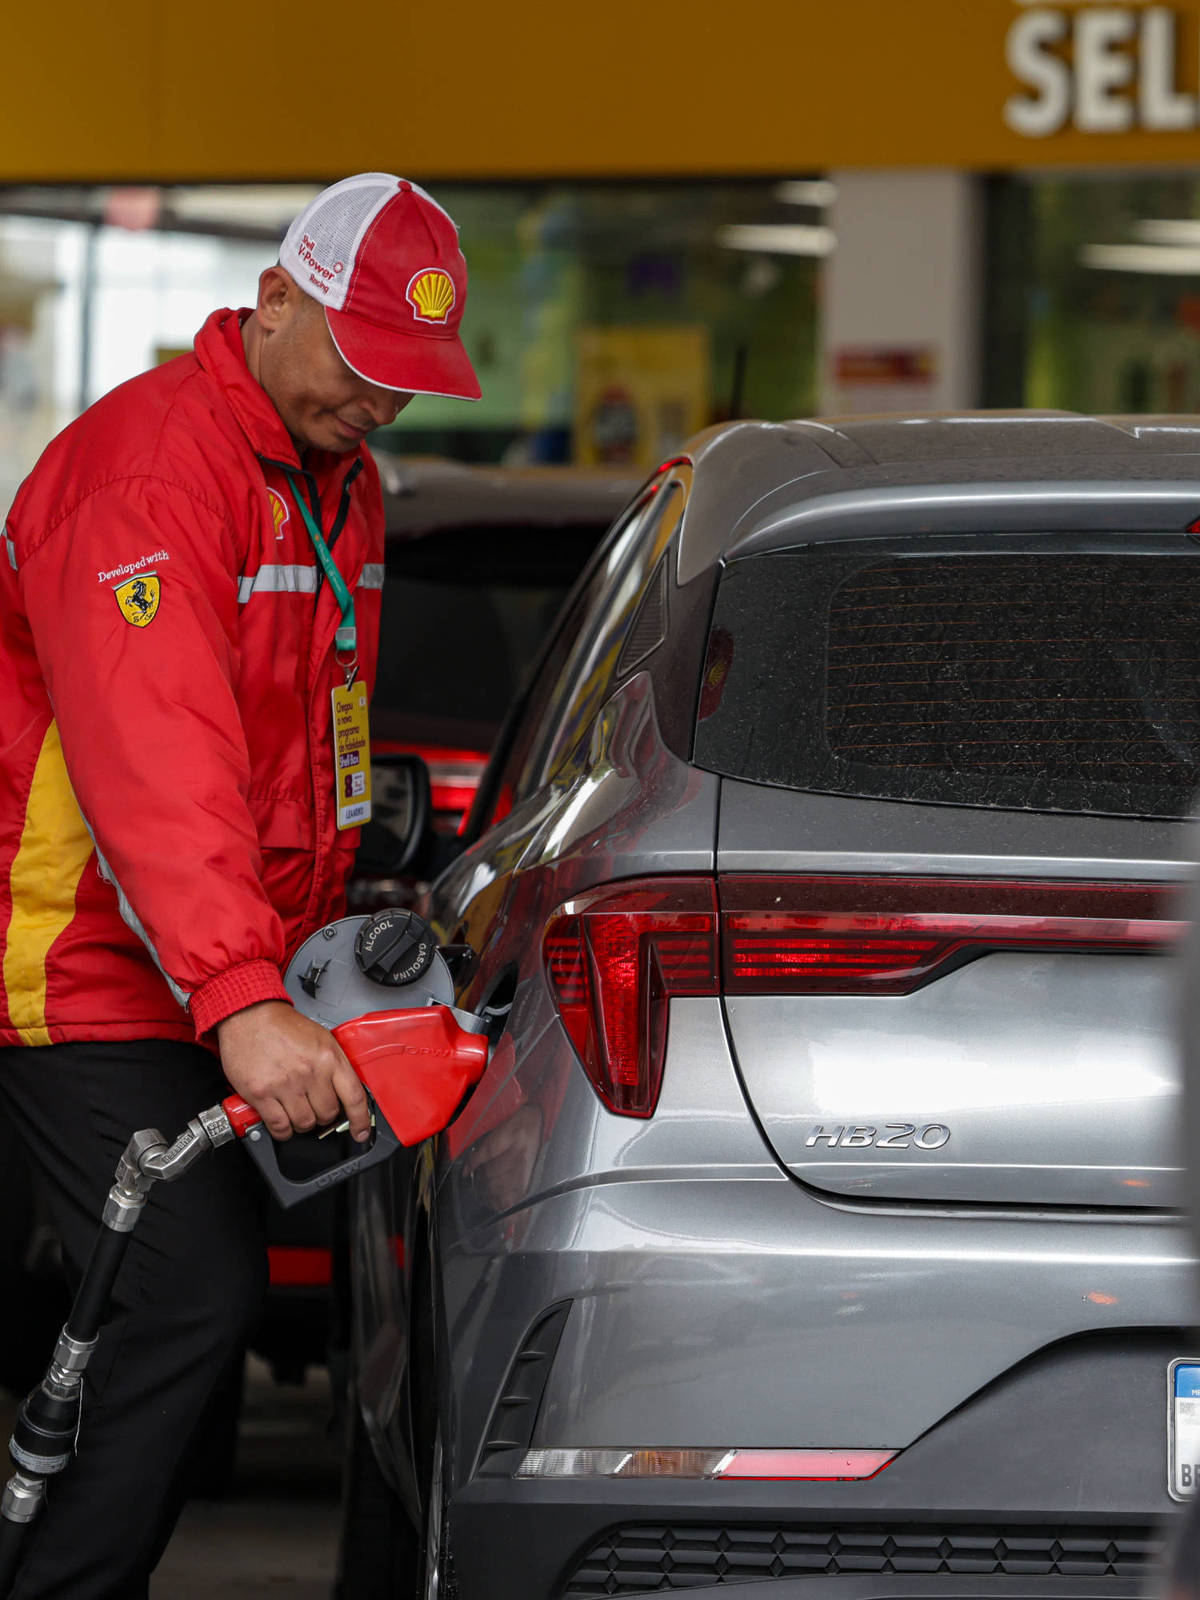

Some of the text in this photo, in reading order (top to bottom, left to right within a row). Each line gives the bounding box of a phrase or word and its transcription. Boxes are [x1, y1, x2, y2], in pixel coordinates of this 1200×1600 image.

[298, 243, 335, 280] V-Power
[309, 273, 330, 295] Racing
[98, 549, 170, 583] Developed with
[365, 920, 394, 952] ALCOOL
[393, 942, 427, 981] GASOLINA
[805, 1122, 951, 1150] HB20
